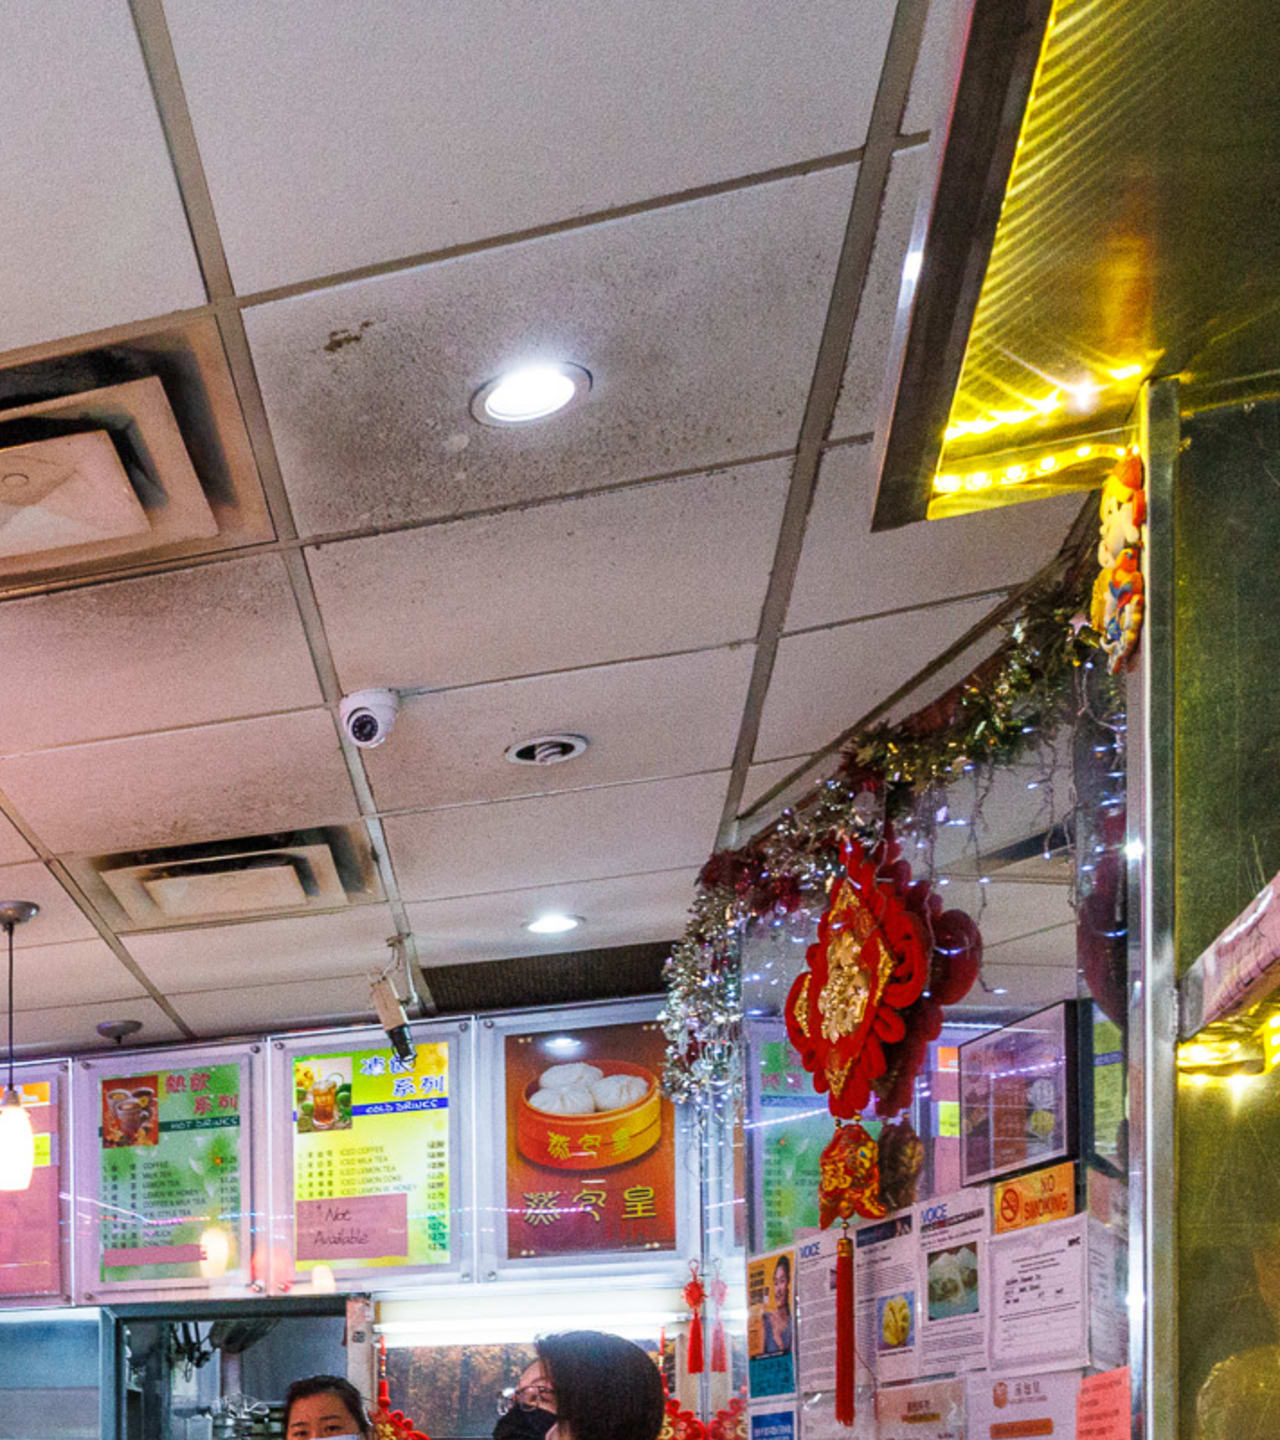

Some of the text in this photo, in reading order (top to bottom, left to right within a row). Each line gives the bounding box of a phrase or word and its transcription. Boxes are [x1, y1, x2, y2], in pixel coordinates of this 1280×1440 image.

[392, 1075, 445, 1097] 系列
[365, 1102, 394, 1114] COLD
[1023, 1192, 1068, 1221] SMOKING
